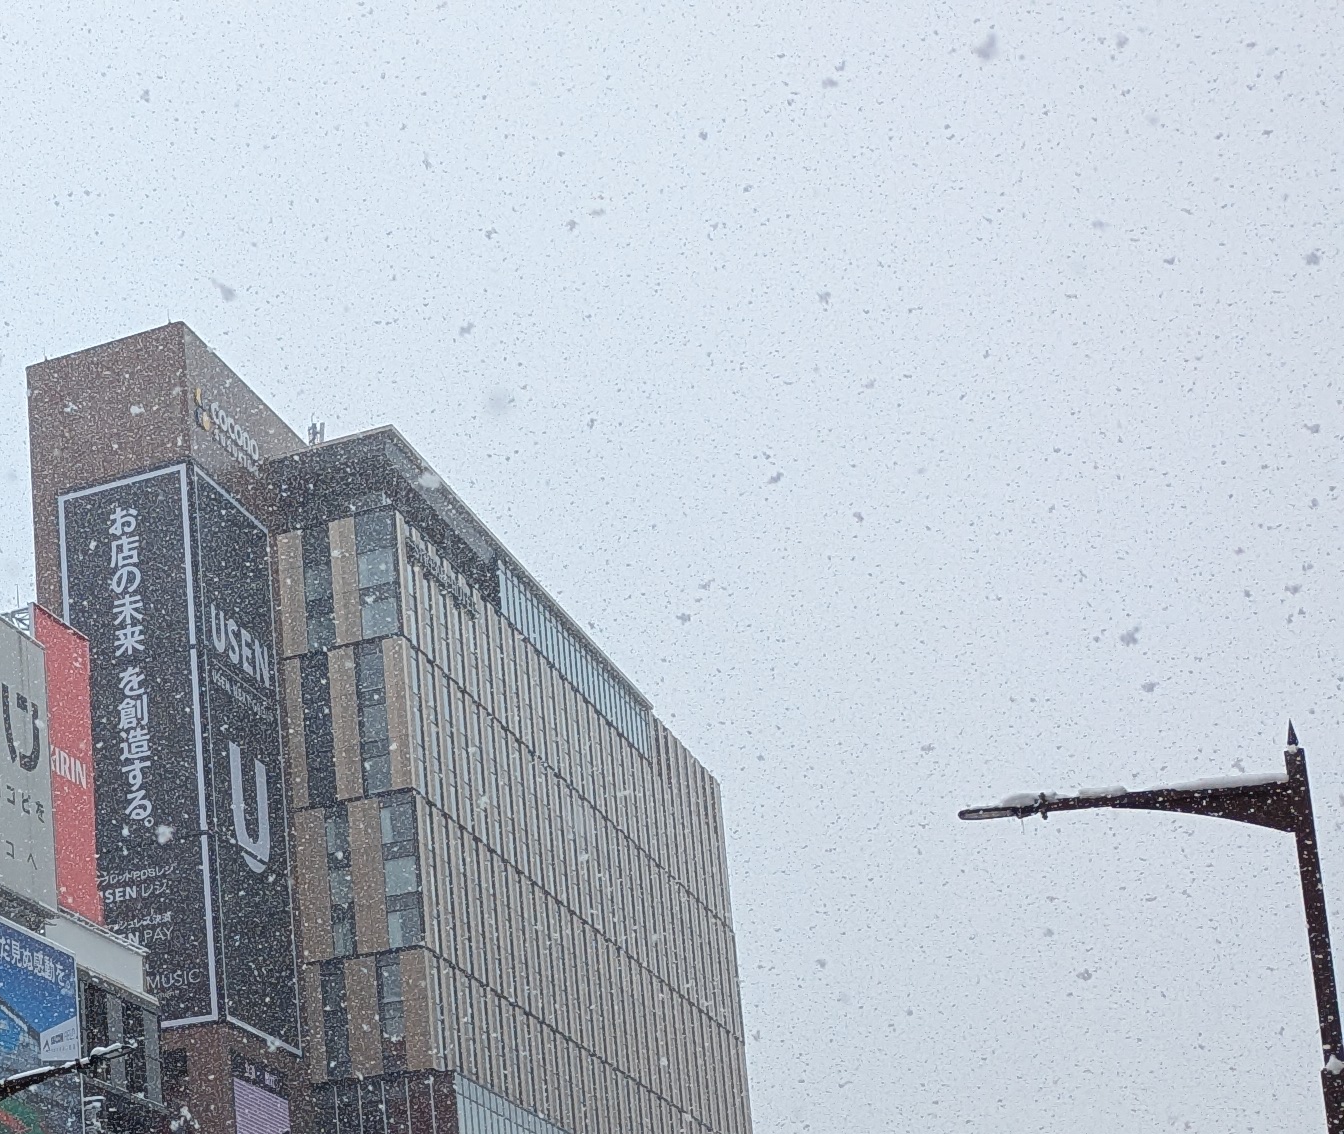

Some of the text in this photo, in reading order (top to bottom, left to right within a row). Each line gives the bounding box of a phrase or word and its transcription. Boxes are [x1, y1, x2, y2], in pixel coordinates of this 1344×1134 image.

[211, 602, 270, 687] USEN
[144, 926, 174, 944] PAY
[146, 968, 202, 990] MUSIC
